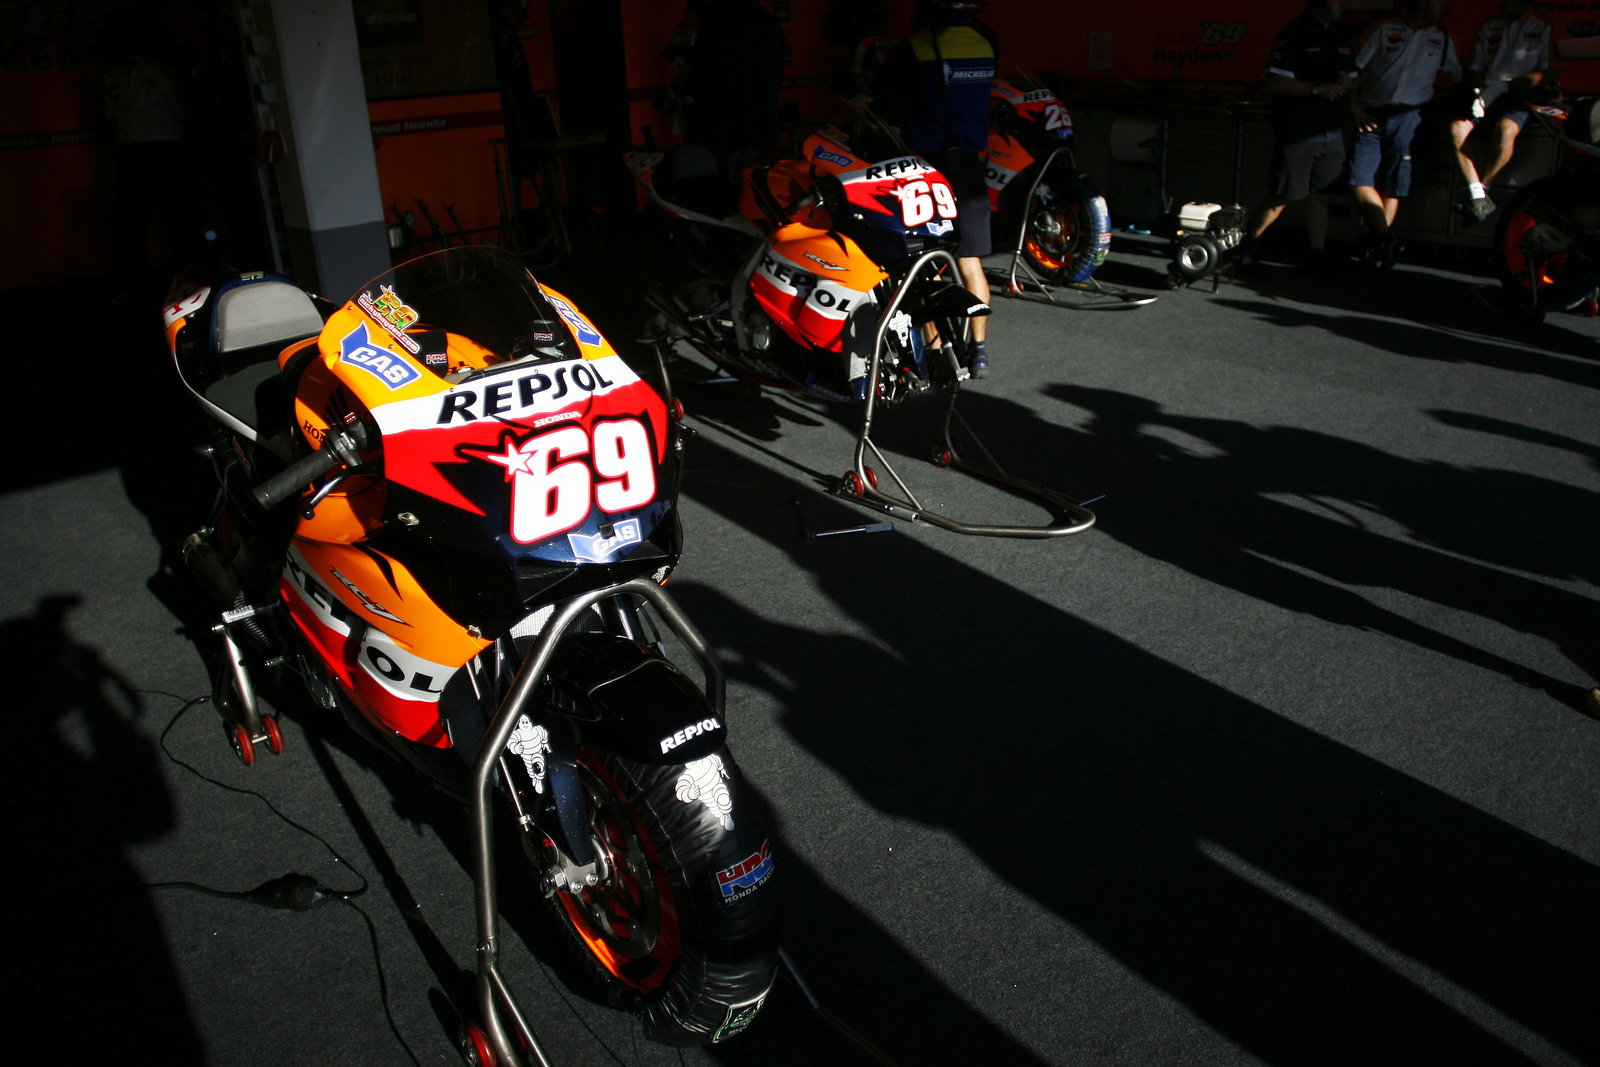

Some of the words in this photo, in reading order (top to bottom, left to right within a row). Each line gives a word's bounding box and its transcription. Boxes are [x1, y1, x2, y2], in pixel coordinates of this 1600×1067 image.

[1154, 46, 1222, 68] Hayden
[403, 118, 448, 132] Honda
[818, 152, 849, 166] GAS
[901, 180, 957, 227] 69
[347, 346, 409, 383] GAS
[437, 363, 613, 425] REPSOL
[533, 411, 582, 428] HONDA
[511, 418, 657, 545] 69
[592, 525, 636, 556] GAS
[660, 717, 721, 754] REPSOL
[724, 884, 758, 904] HONDA
